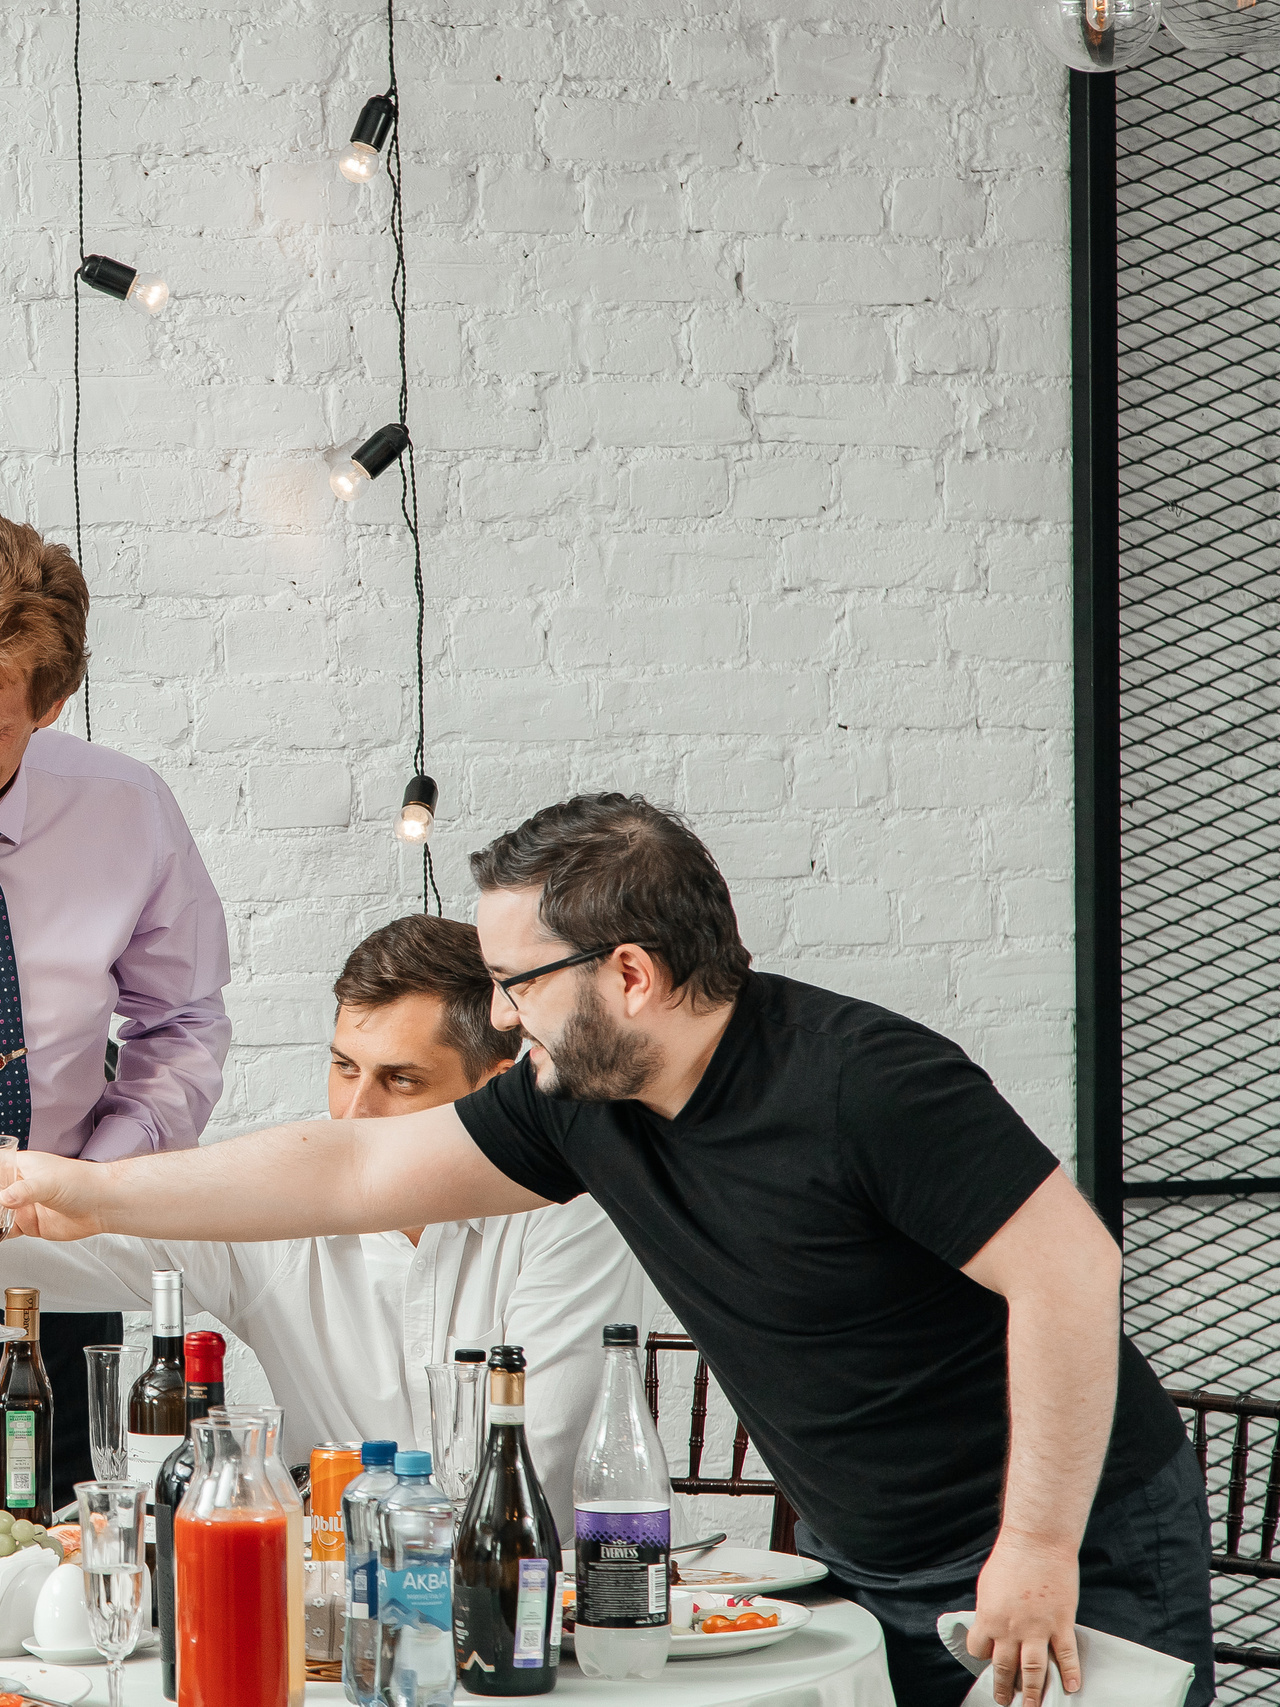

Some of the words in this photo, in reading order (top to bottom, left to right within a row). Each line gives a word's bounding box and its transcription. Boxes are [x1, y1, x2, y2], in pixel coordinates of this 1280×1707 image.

[312, 1510, 345, 1534] рый
[600, 1546, 639, 1559] EVERVESS
[402, 1571, 449, 1592] АКВА
